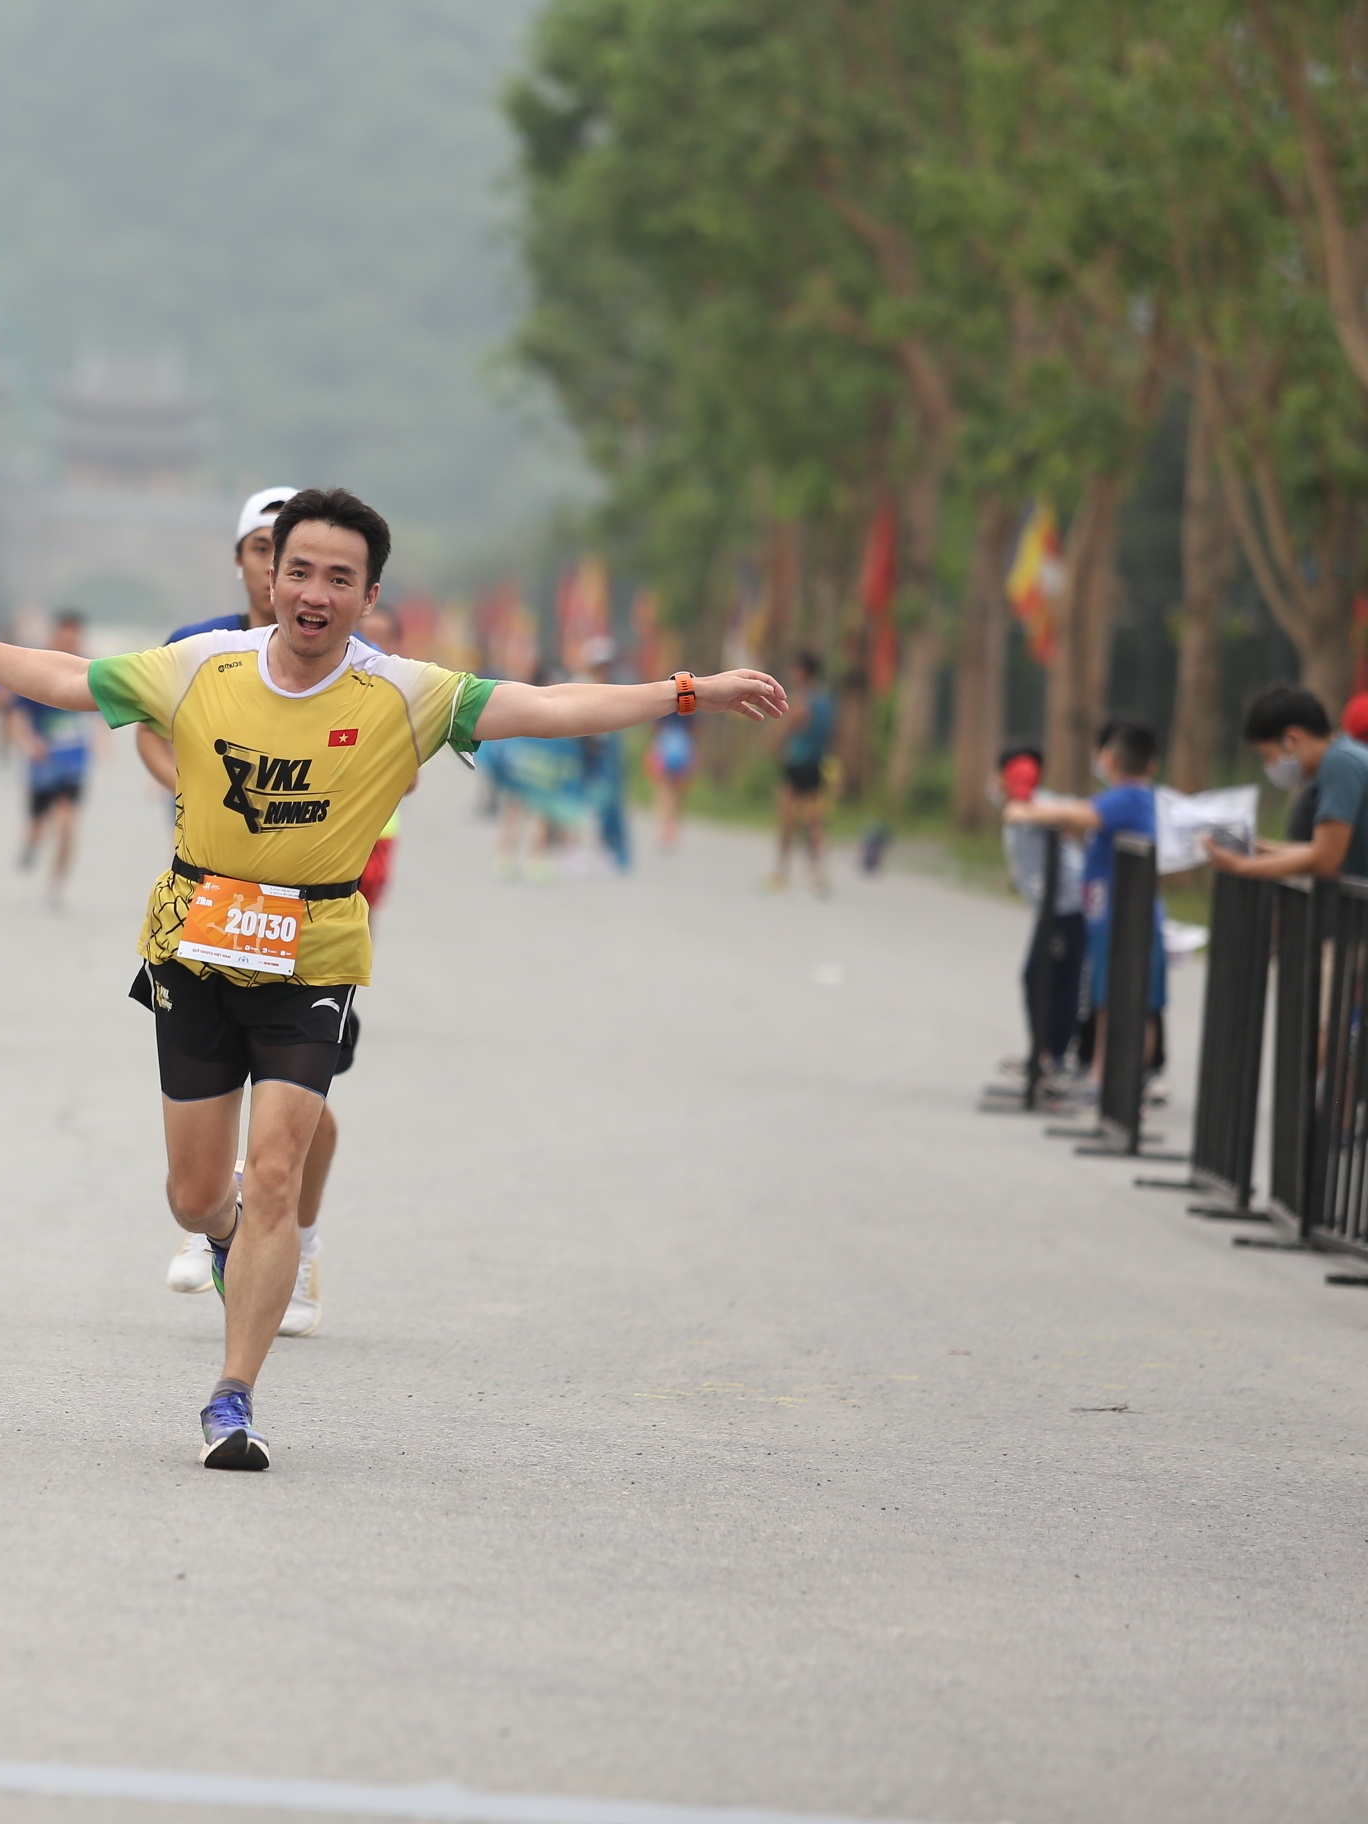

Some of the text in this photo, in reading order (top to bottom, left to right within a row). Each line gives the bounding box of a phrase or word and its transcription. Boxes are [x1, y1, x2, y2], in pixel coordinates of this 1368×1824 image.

[256, 755, 313, 791] VKL
[263, 799, 331, 825] RUNNERS
[196, 896, 213, 907] 21km
[224, 908, 297, 943] 20130
